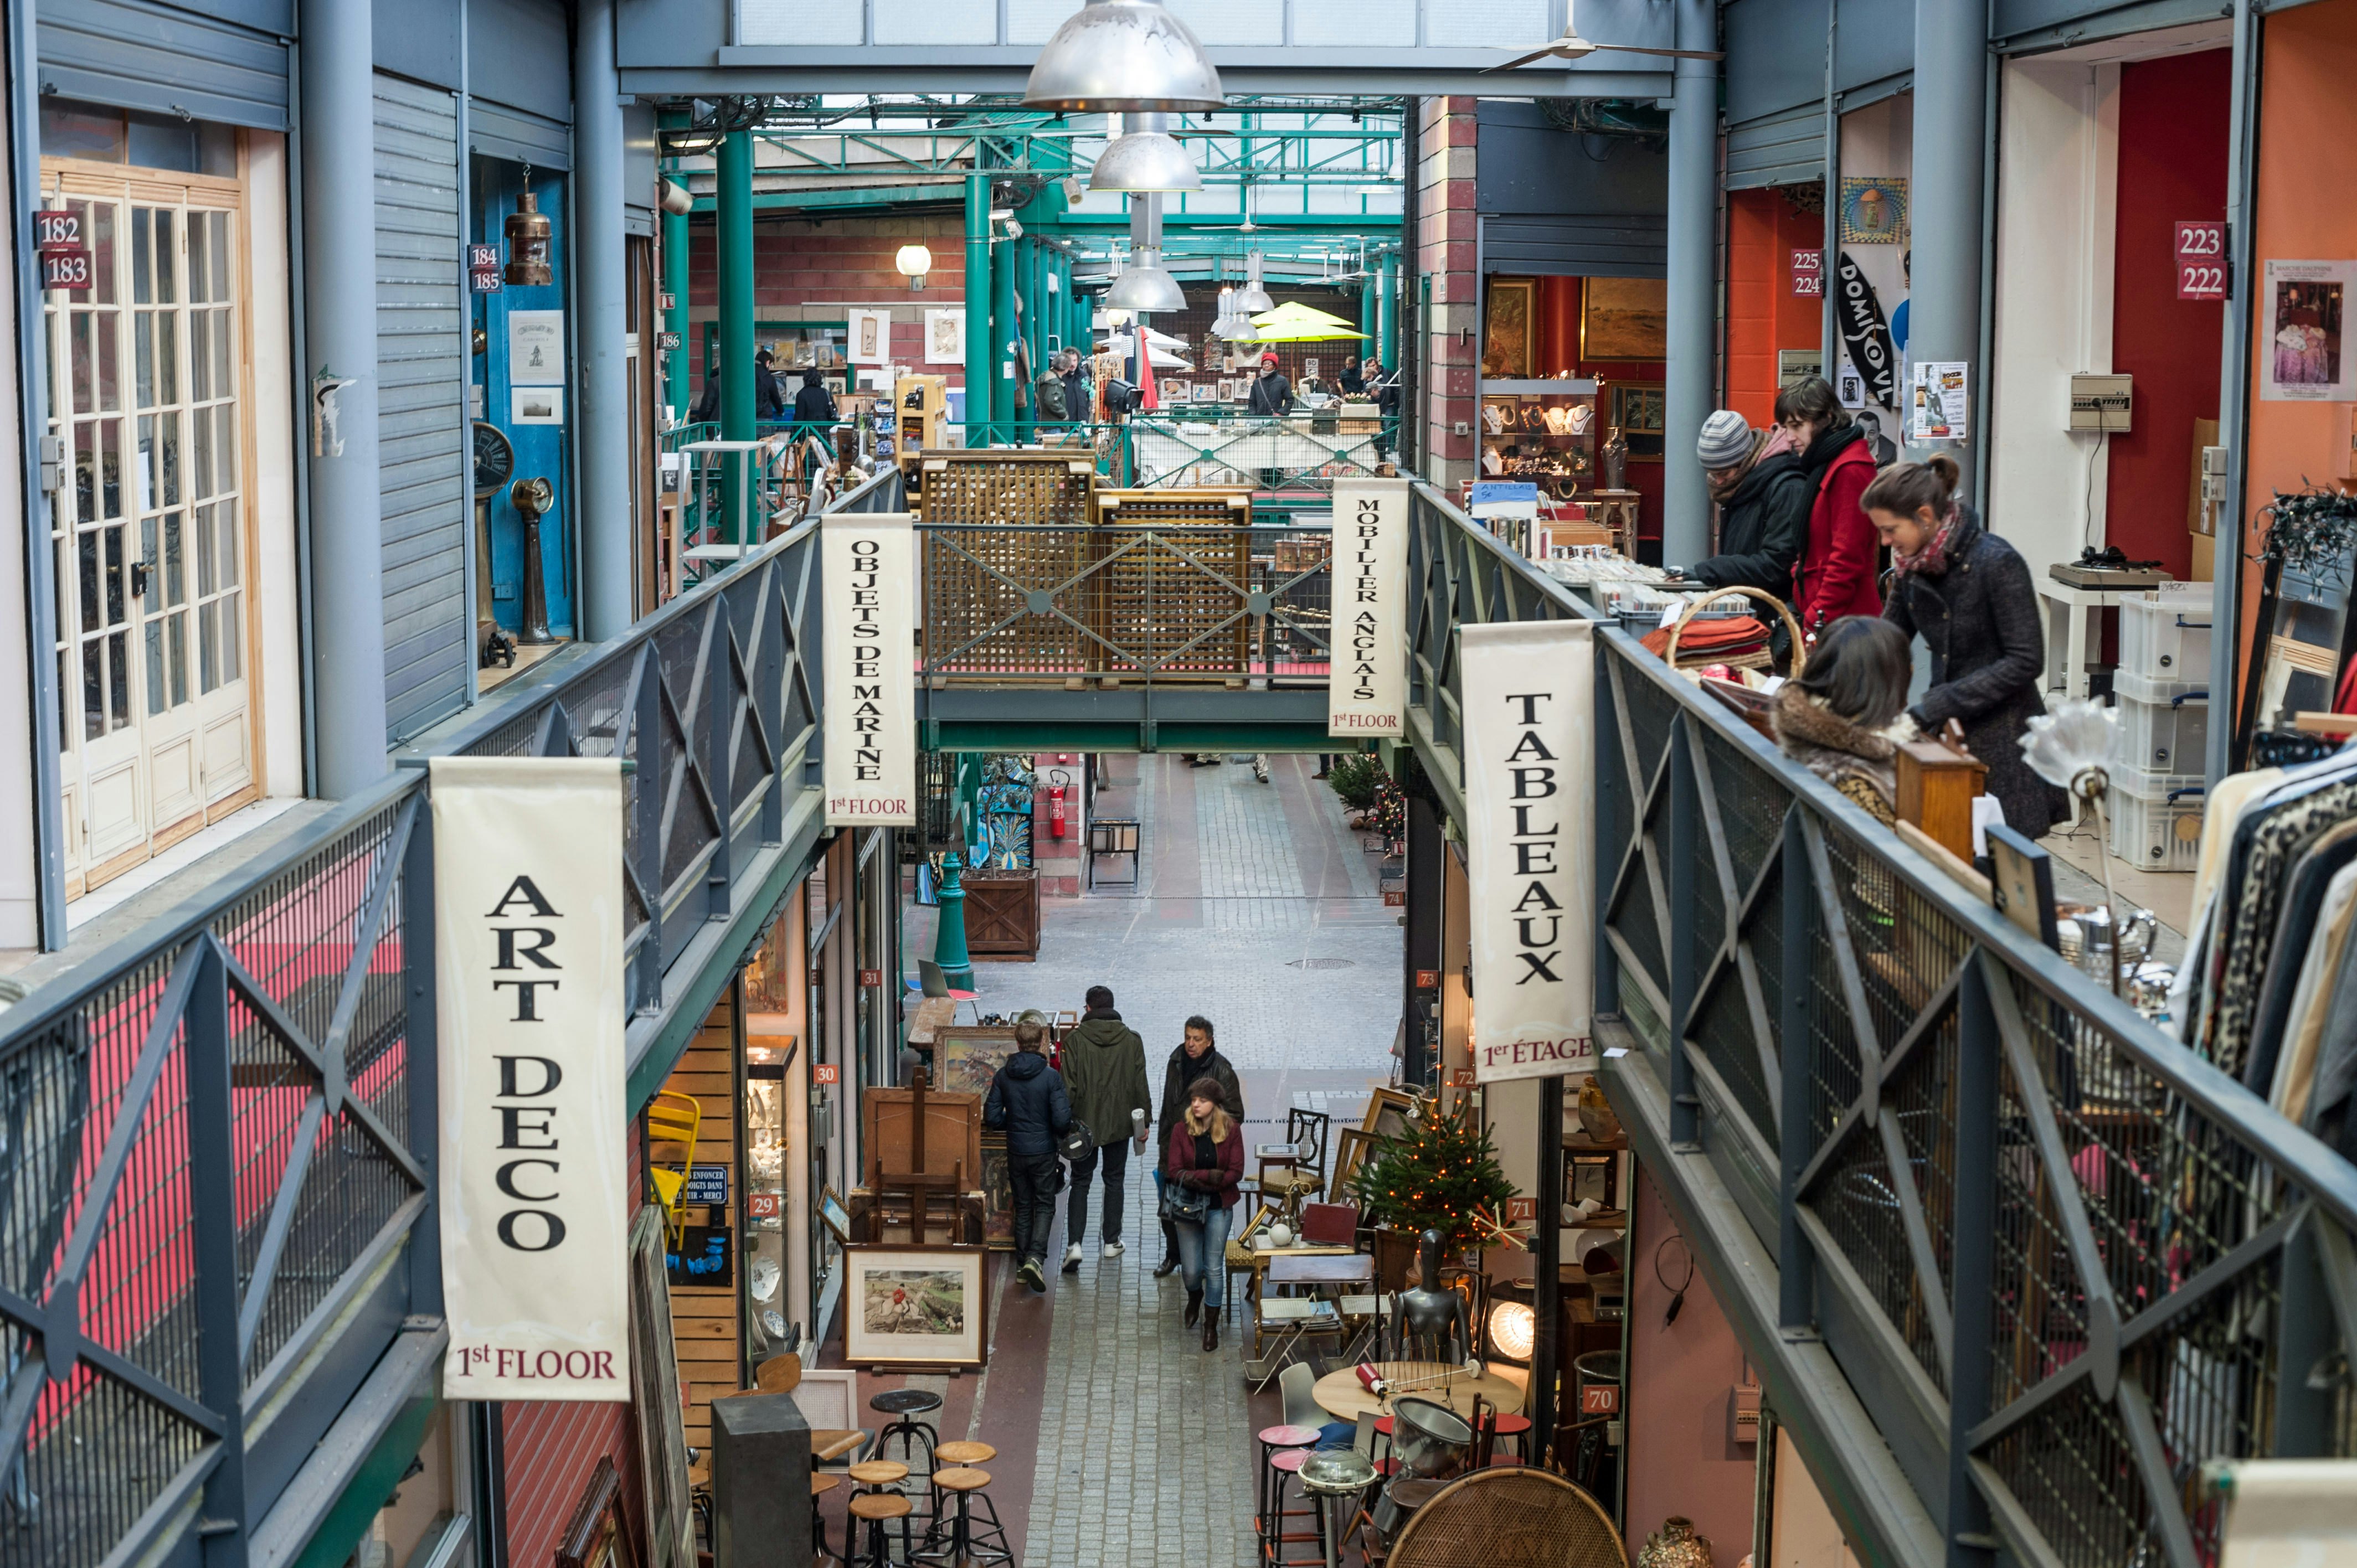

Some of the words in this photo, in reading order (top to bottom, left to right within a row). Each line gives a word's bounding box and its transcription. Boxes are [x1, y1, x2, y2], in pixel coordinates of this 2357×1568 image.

[41, 218, 79, 243] 182
[2181, 229, 2220, 254] 223
[473, 248, 497, 265] 184
[1794, 253, 1819, 269] 225
[49, 257, 86, 283] 183
[475, 273, 499, 289] 185
[1795, 277, 1820, 293] 224
[2184, 268, 2222, 293] 222
[661, 335, 680, 347] 186
[1355, 499, 1380, 602] MOBILIER
[851, 540, 880, 638] OBJETS
[853, 646, 881, 677] DE
[1352, 611, 1378, 699] ANGLAIS
[1333, 714, 1346, 727] 1st
[1349, 715, 1397, 728] FLOOR
[852, 685, 884, 780] MARINE
[829, 798, 846, 814] 1st
[850, 799, 907, 814] FLOOR
[1505, 693, 1563, 986] TABLEAUX
[1389, 894, 1399, 904] 74
[484, 875, 564, 1022] ART
[865, 973, 878, 984] 31
[1421, 974, 1434, 984] 73
[1484, 1045, 1509, 1066] 1er
[1512, 1036, 1592, 1064] ÉTAGE
[818, 1068, 834, 1081] 30
[1458, 1072, 1474, 1084] 72
[491, 1055, 566, 1252] DECO
[754, 1198, 773, 1213] 29
[1512, 1201, 1531, 1216] 71
[457, 1344, 490, 1377] 1st
[496, 1349, 616, 1379] FLOOR
[1589, 1390, 1612, 1409] 70
